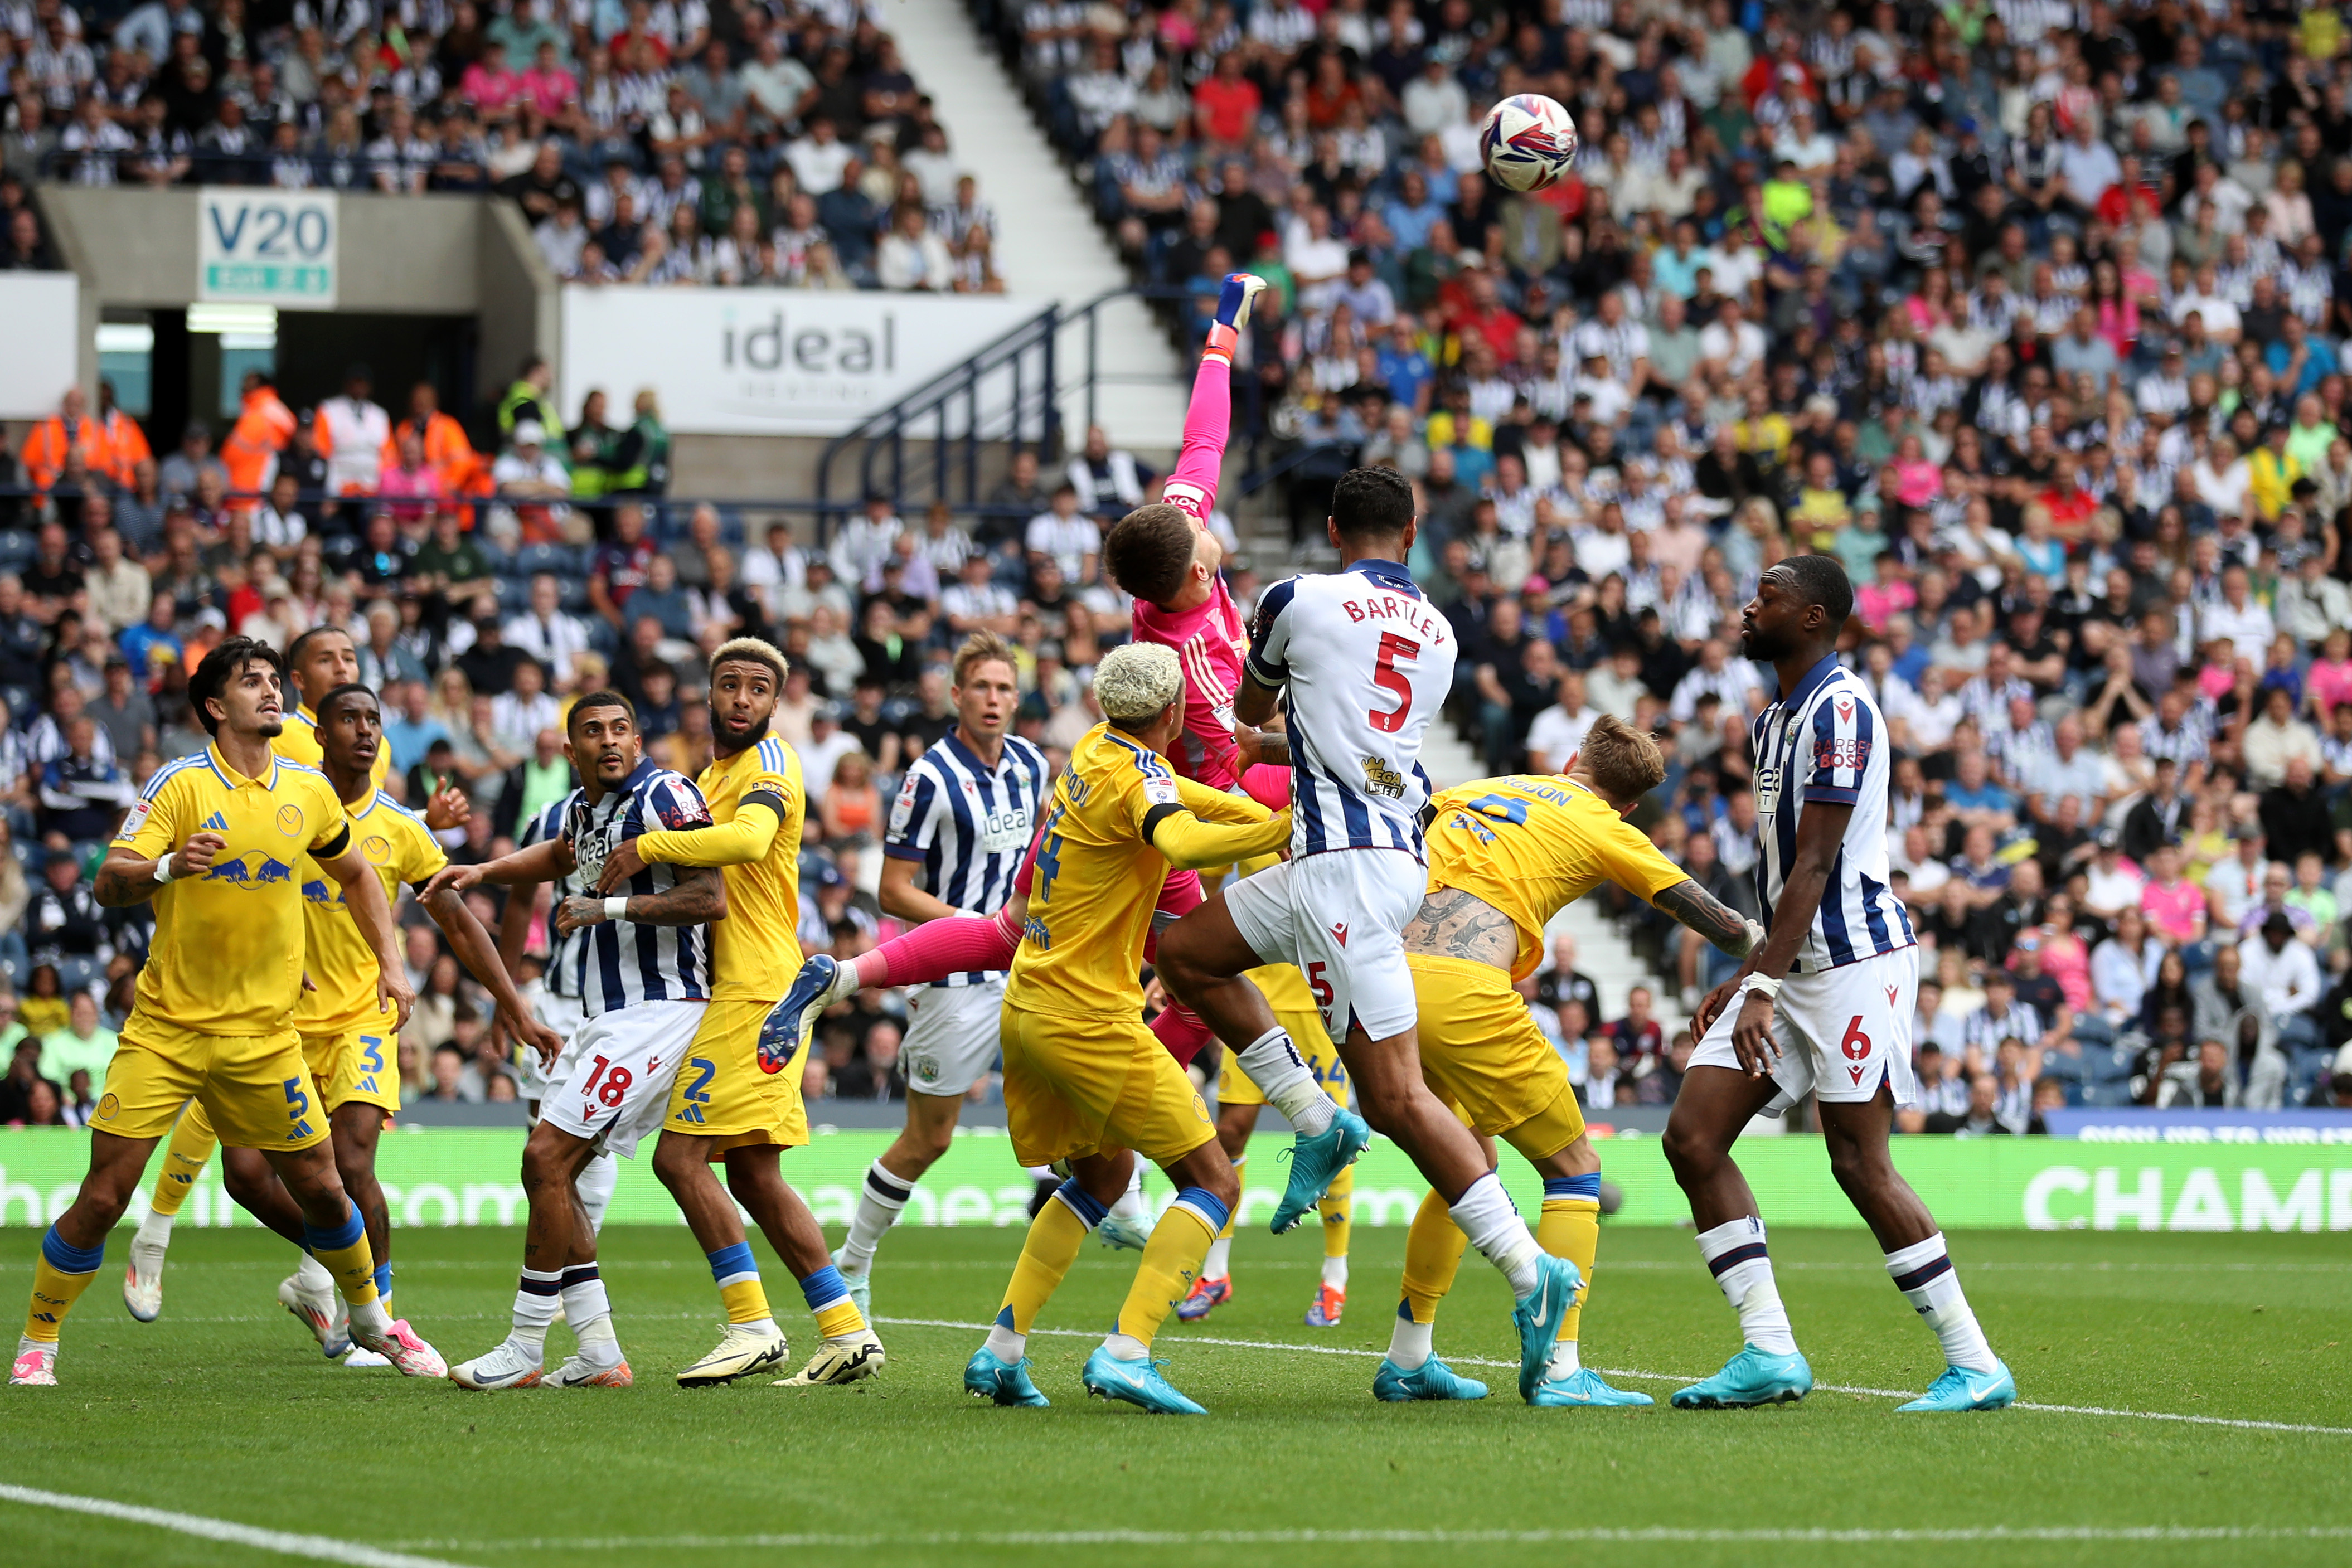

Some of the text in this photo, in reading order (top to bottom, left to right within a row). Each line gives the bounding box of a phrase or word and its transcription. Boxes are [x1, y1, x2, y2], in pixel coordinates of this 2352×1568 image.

[208, 205, 328, 259] V20
[724, 306, 894, 374] ideal
[1342, 596, 1445, 647] BARTLEY
[1369, 630, 1420, 733] 5
[1814, 739, 1872, 757] BARBER
[1820, 753, 1864, 770] BOSS
[658, 799, 707, 827] BARBE
[982, 802, 1031, 836] ideal
[578, 829, 612, 867] ideal
[1308, 961, 1334, 1007] 5
[360, 1035, 384, 1074] 3
[1841, 1015, 1871, 1061] 6
[283, 1077, 308, 1119] 5
[581, 1054, 632, 1108] 18
[683, 1058, 716, 1103] 2
